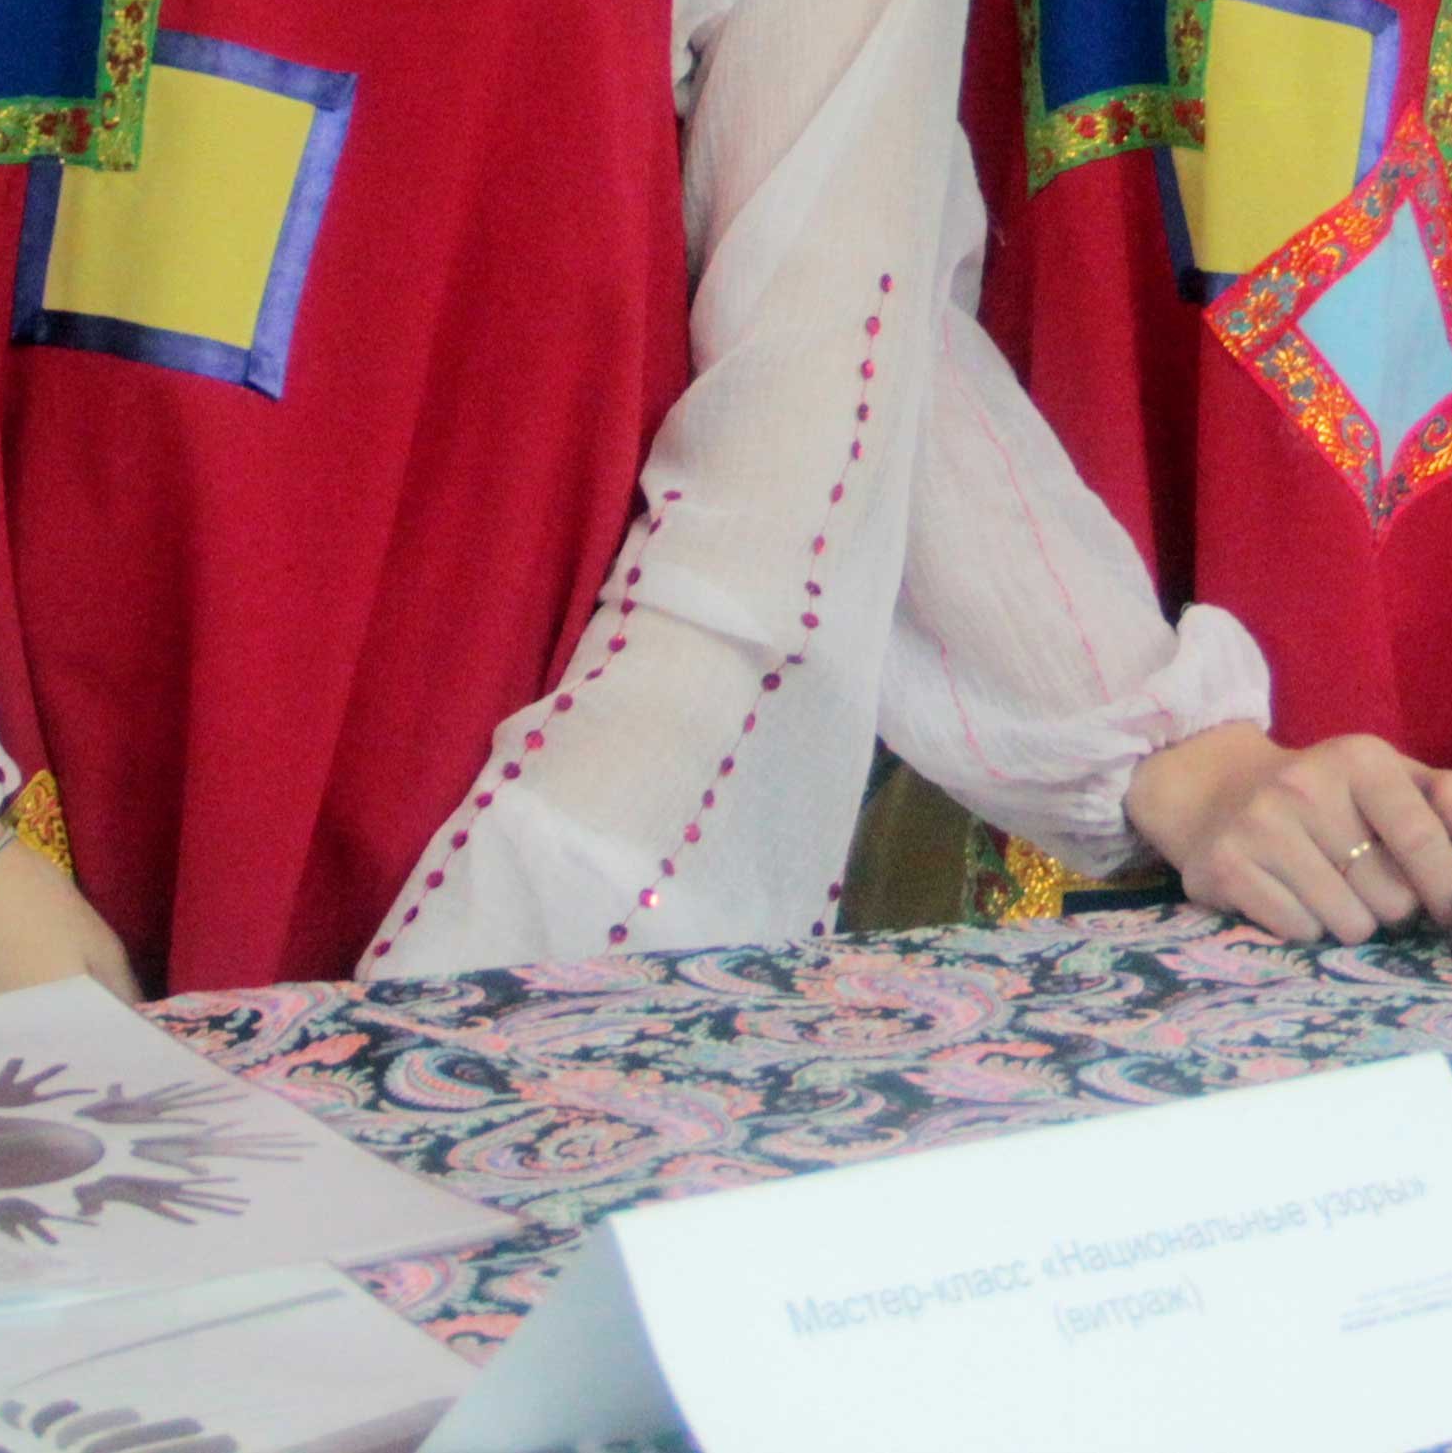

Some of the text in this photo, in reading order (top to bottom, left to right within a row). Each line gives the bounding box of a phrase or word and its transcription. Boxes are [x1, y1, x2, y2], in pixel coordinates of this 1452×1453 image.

[786, 1175, 1427, 1338] Мастер-класс «Национальные узоры»
[1053, 1275, 1205, 1344] (витраж)
